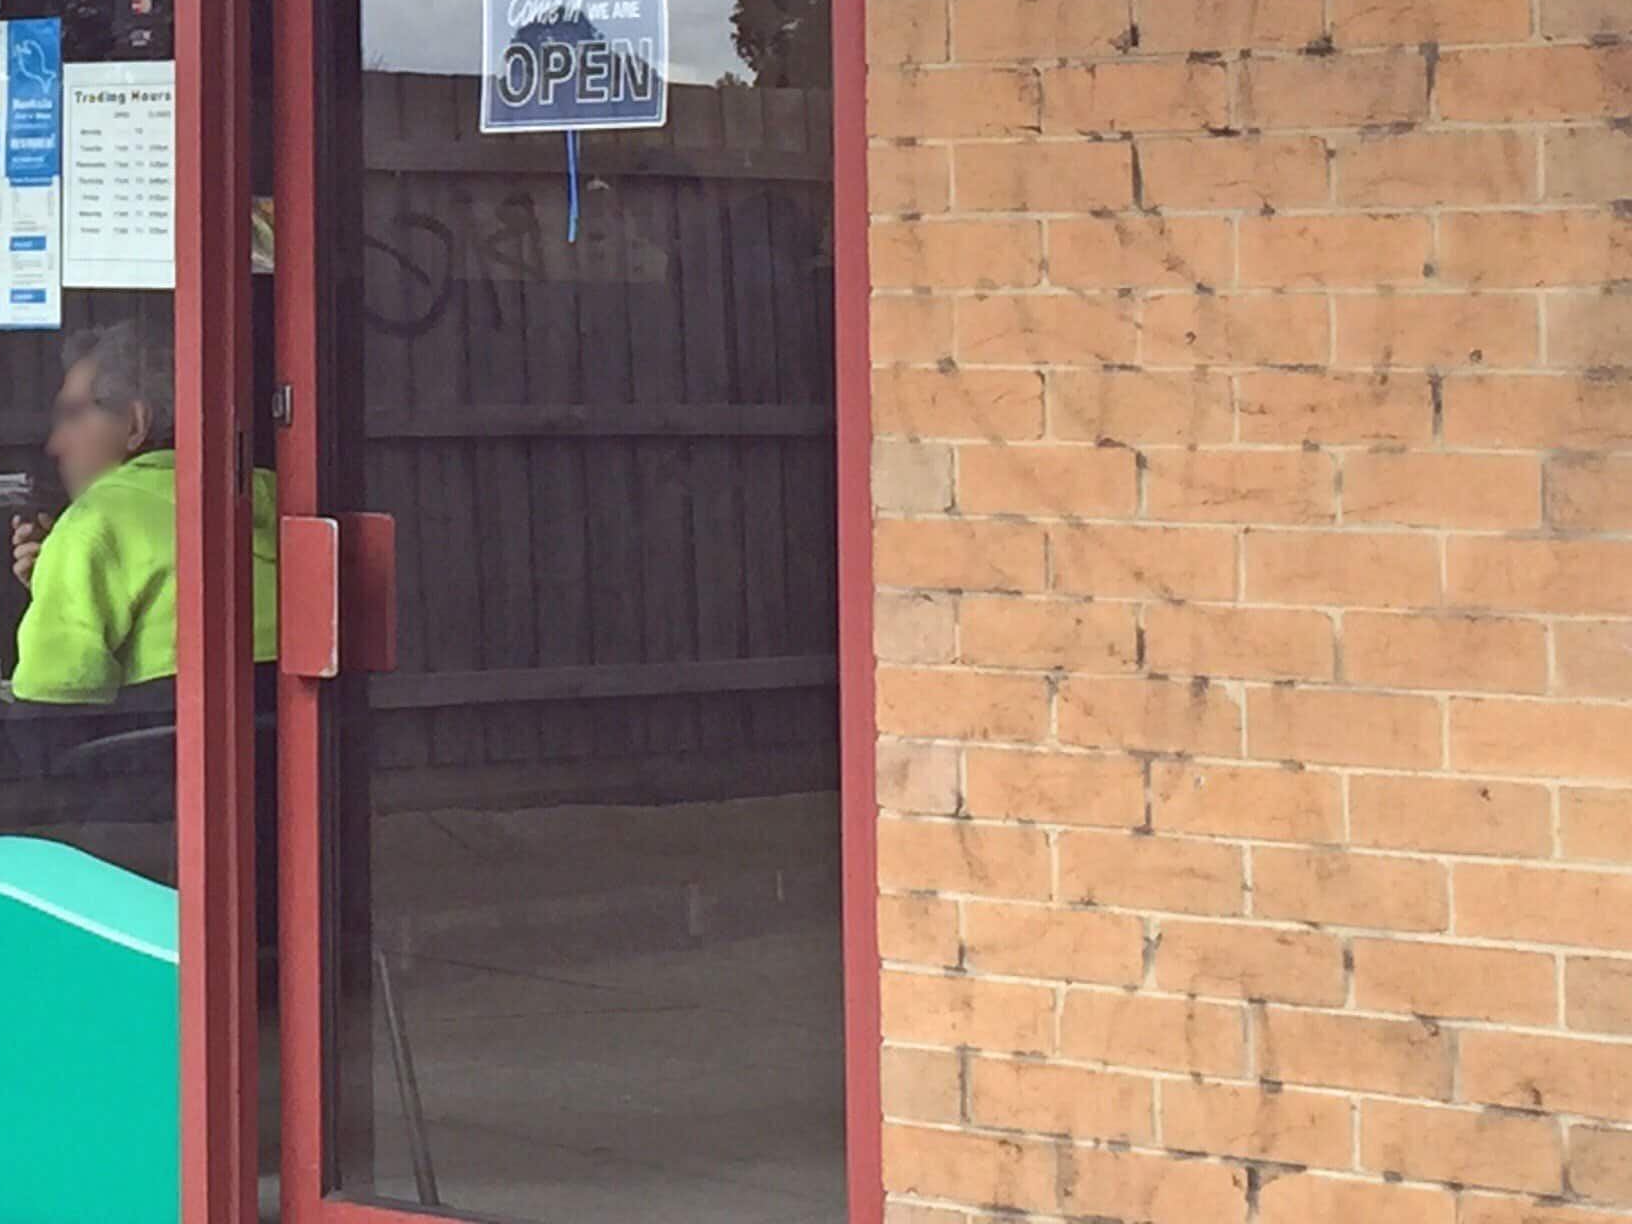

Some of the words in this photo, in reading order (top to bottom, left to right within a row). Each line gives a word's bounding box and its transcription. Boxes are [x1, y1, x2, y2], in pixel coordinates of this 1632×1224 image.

[586, 3, 610, 20] WE
[612, 0, 641, 19] ARE
[497, 36, 654, 108] OPEN
[74, 90, 126, 104] Trading
[131, 90, 171, 102] Hours
